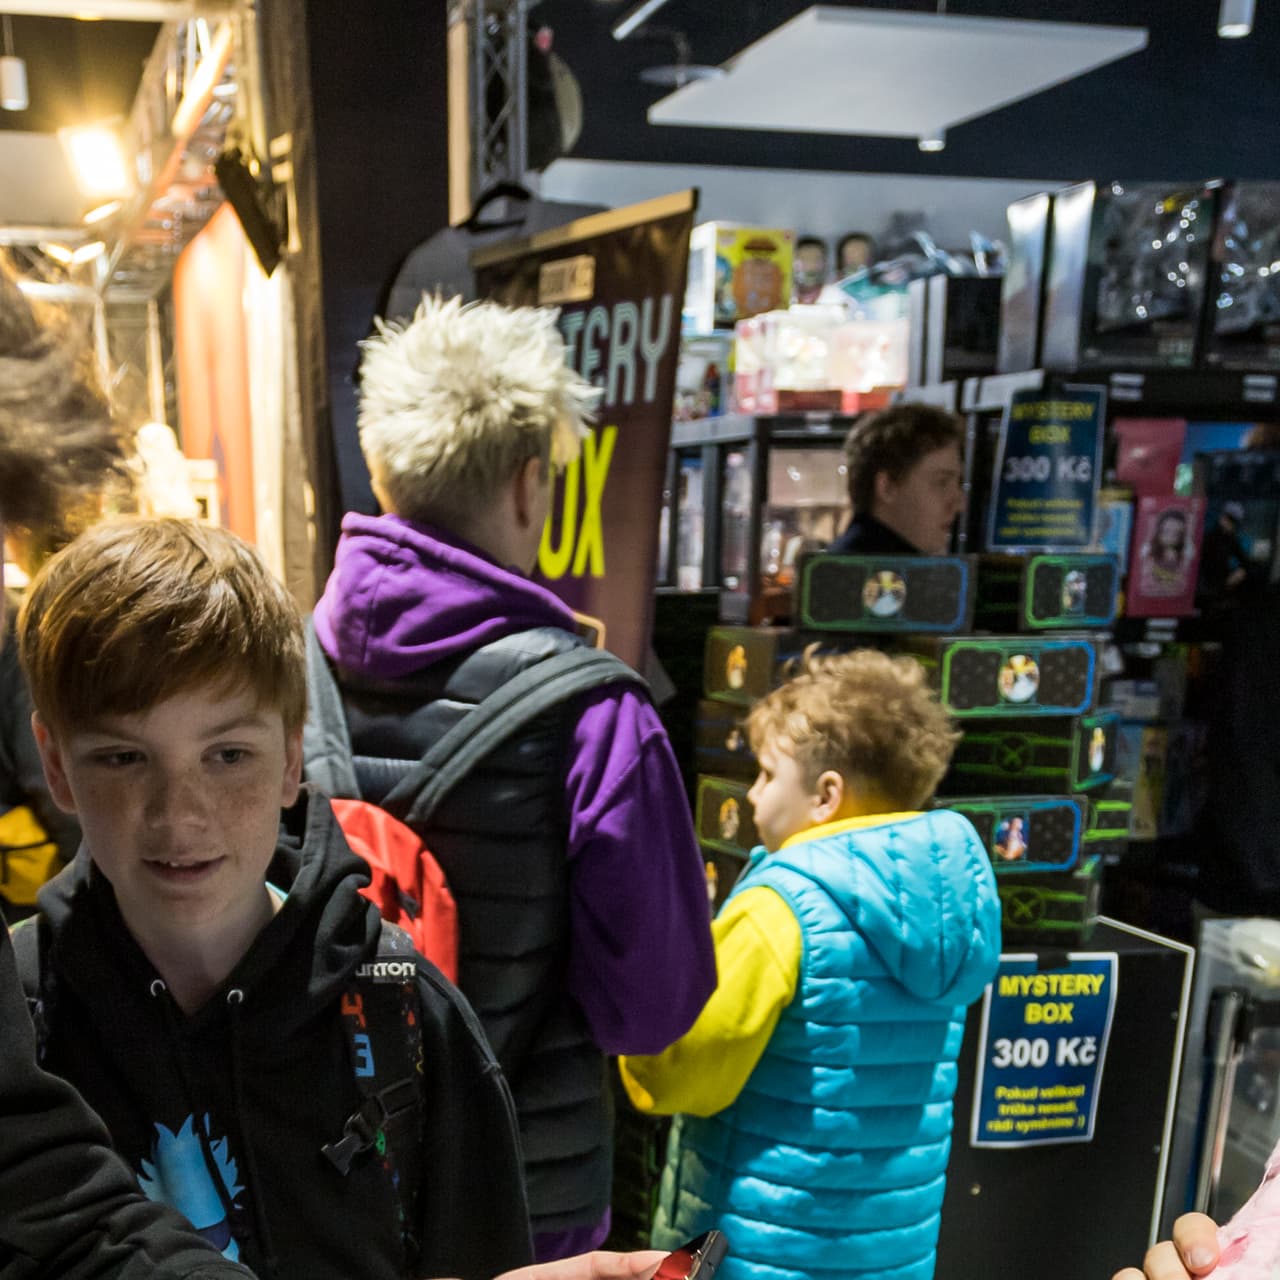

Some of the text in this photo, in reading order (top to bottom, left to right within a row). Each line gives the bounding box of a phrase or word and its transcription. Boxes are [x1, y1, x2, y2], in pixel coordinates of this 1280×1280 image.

[561, 294, 673, 408] TERY
[538, 424, 618, 579] OX
[998, 974, 1105, 996] MYSTERY
[1024, 1002, 1075, 1024] BOX
[992, 1036, 1097, 1068] 300 Kč
